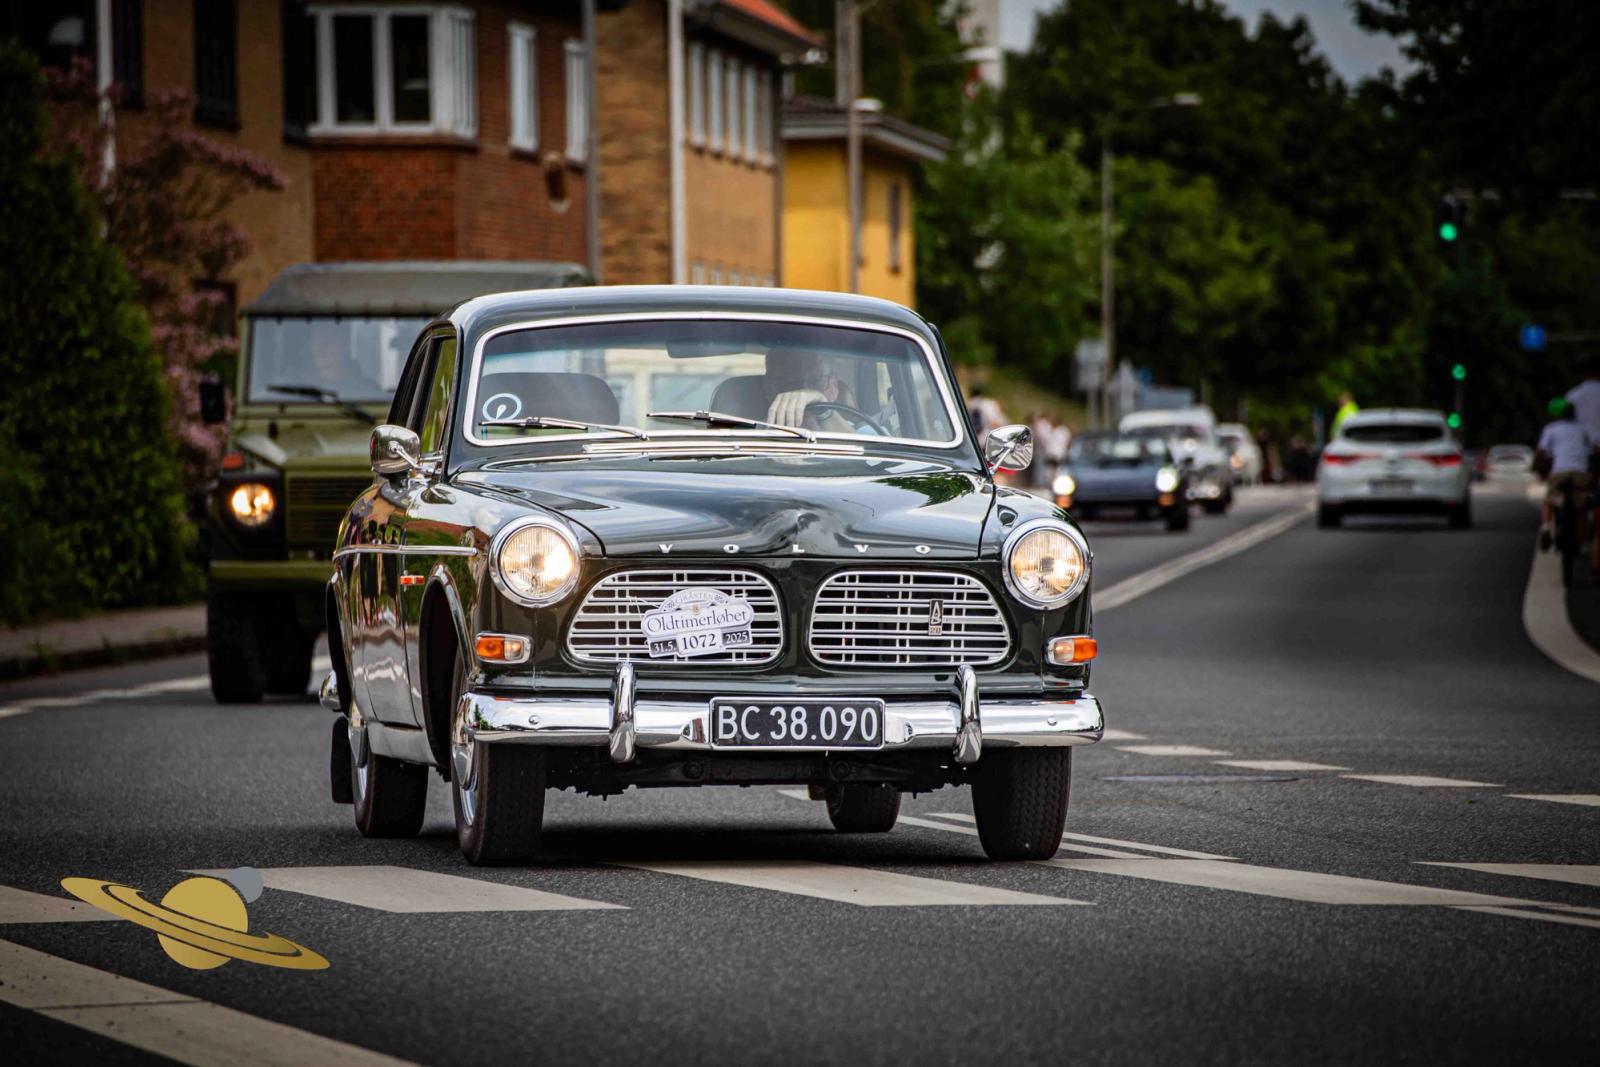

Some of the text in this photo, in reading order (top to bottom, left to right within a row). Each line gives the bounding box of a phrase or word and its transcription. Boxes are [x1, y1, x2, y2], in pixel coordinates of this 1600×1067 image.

[659, 544, 931, 554] VOLVO
[647, 608, 747, 633] Oldtimerløbet
[653, 632, 748, 653] 31.5. 1072 2025
[718, 705, 878, 742] BC 38.090
